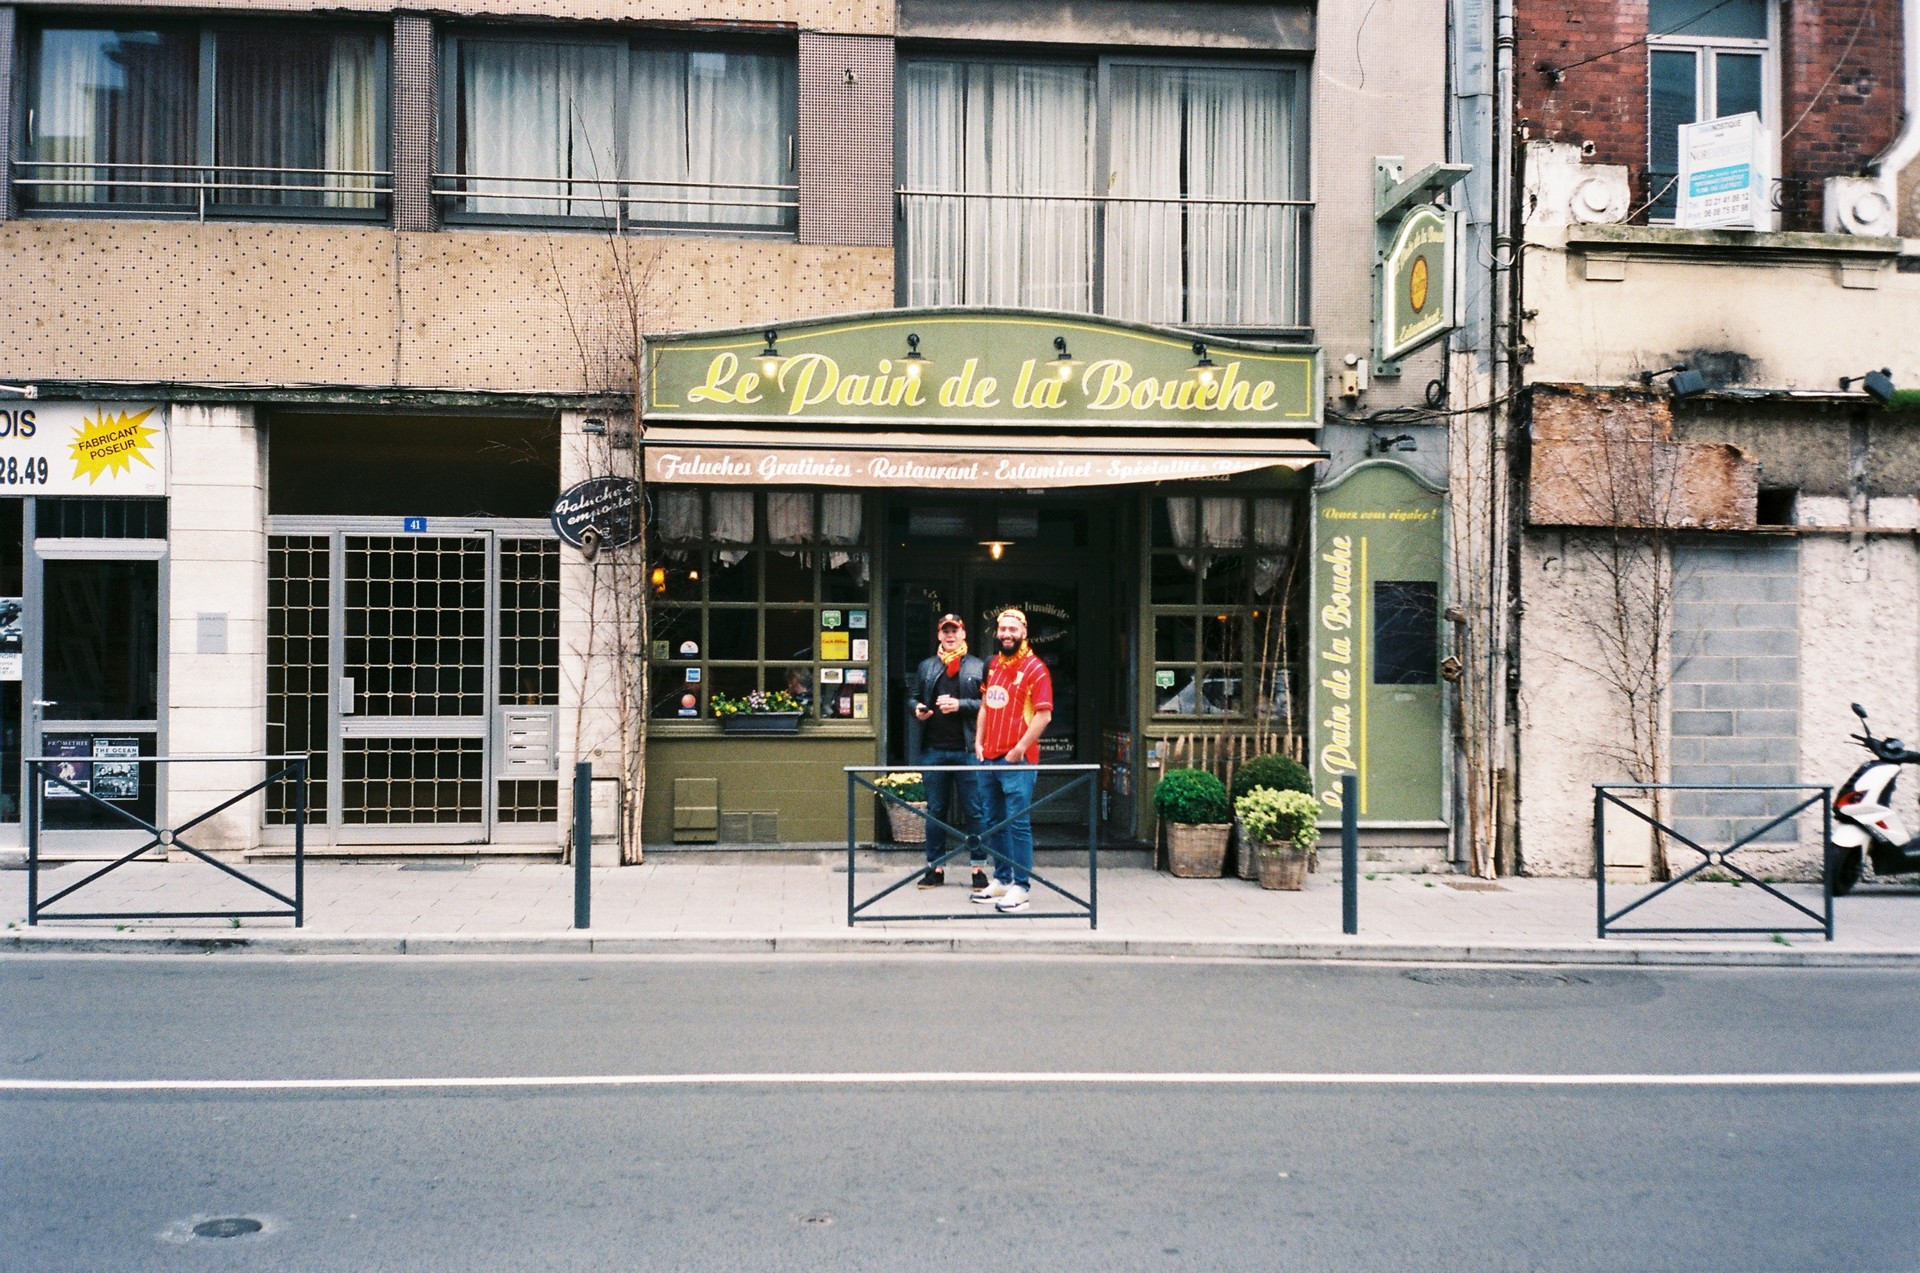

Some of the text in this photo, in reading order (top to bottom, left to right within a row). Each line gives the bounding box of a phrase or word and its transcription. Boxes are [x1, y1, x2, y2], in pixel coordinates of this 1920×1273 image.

[687, 351, 1279, 416] Le Pain de la Bouche
[79, 425, 139, 451] FABRICANT
[90, 439, 136, 460] POSEUR
[657, 454, 752, 479] Faluches
[757, 455, 852, 480] Gratinées
[868, 457, 979, 480] Restaurant
[995, 459, 1092, 480] Estaminet
[1107, 459, 1207, 480] Spécialités
[410, 520, 421, 530] 41
[1321, 535, 1352, 631] Bouche
[1322, 636, 1351, 665] la
[1322, 668, 1351, 699] de
[1321, 704, 1357, 775] Pain
